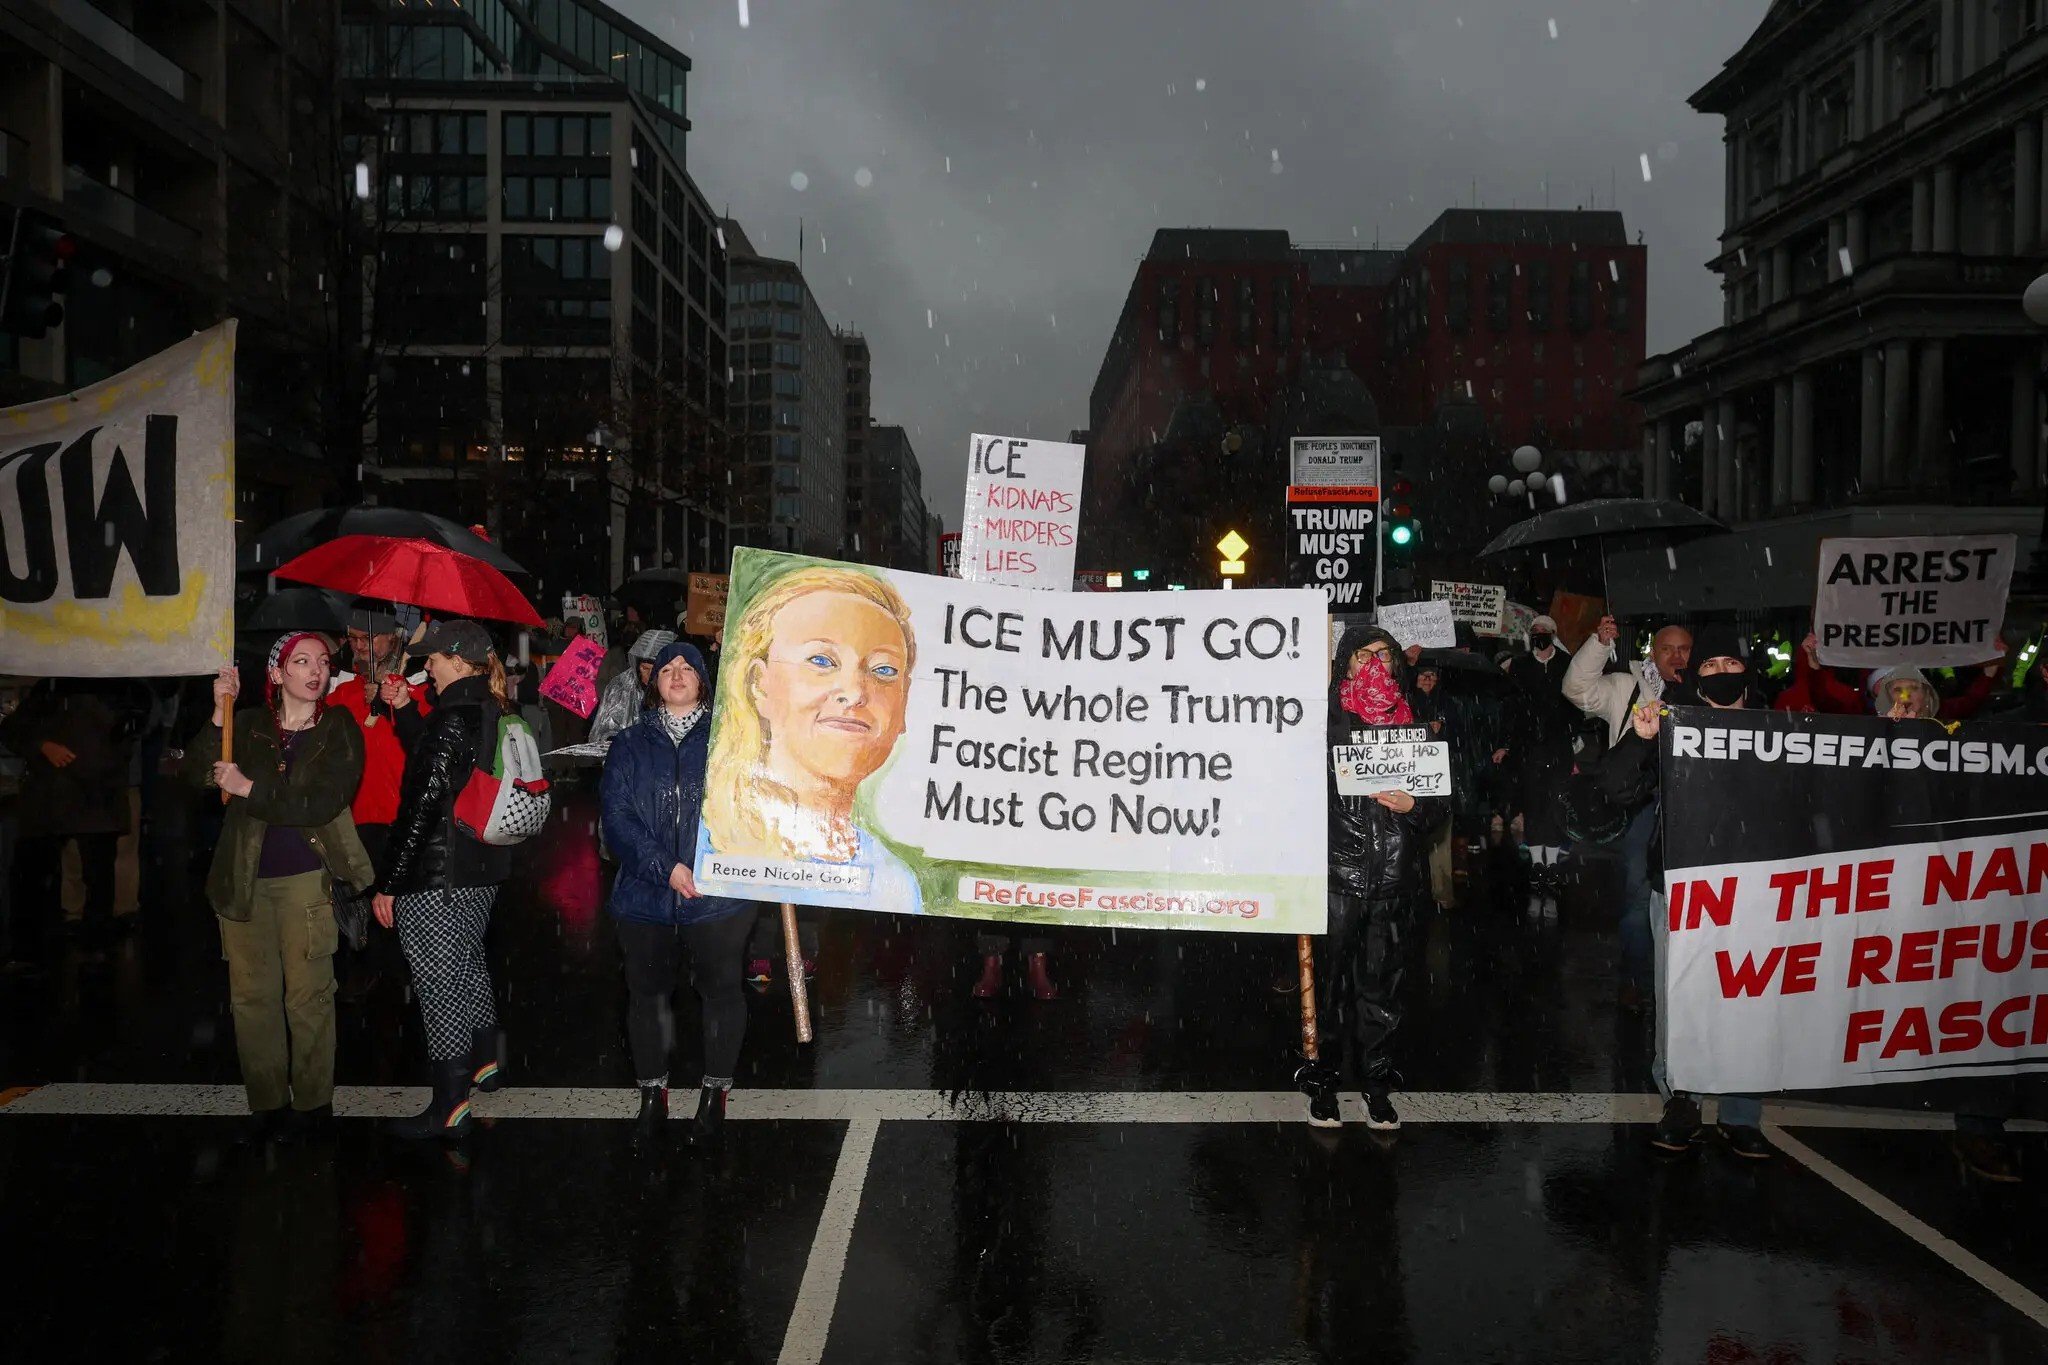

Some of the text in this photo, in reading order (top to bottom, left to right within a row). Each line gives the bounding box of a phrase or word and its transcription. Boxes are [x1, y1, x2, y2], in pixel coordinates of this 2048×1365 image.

[974, 438, 1029, 479] ICE
[1297, 442, 1374, 451] THE PEOPLE'S INDICTMENT
[1308, 455, 1364, 464] DONALD TRUMP
[987, 483, 1073, 513] KIDNAPS
[1293, 487, 1373, 497] RefuseFascism.org
[1291, 508, 1374, 530] TRUMP
[985, 517, 1074, 547] MURDERS
[1299, 533, 1365, 555] MUST
[985, 549, 1037, 574] LIES
[1315, 558, 1350, 580] GO
[1826, 548, 1998, 586] ARREST
[1303, 582, 1363, 604] OW!
[1453, 583, 1471, 594] Party
[1483, 588, 1492, 596] you
[1881, 590, 1939, 616] THE
[943, 602, 1301, 661] ICE MUST GO!
[1823, 619, 1990, 648] PRESIDENT
[933, 665, 1304, 734] The whole Trump
[1362, 729, 1378, 744] WILL
[1398, 727, 1427, 742] SILENCED
[928, 722, 1233, 786] Fascist Regime
[1336, 746, 1374, 764] HAVE
[1411, 744, 1440, 758] HAD
[1354, 760, 1417, 776] ENOUGH
[922, 777, 1222, 839] Must Go Now!
[711, 862, 757, 878] Renee
[763, 866, 813, 882] Nicole
[1668, 876, 1739, 932] IN
[1768, 858, 1896, 923] THE
[1714, 941, 1823, 1000] WE
